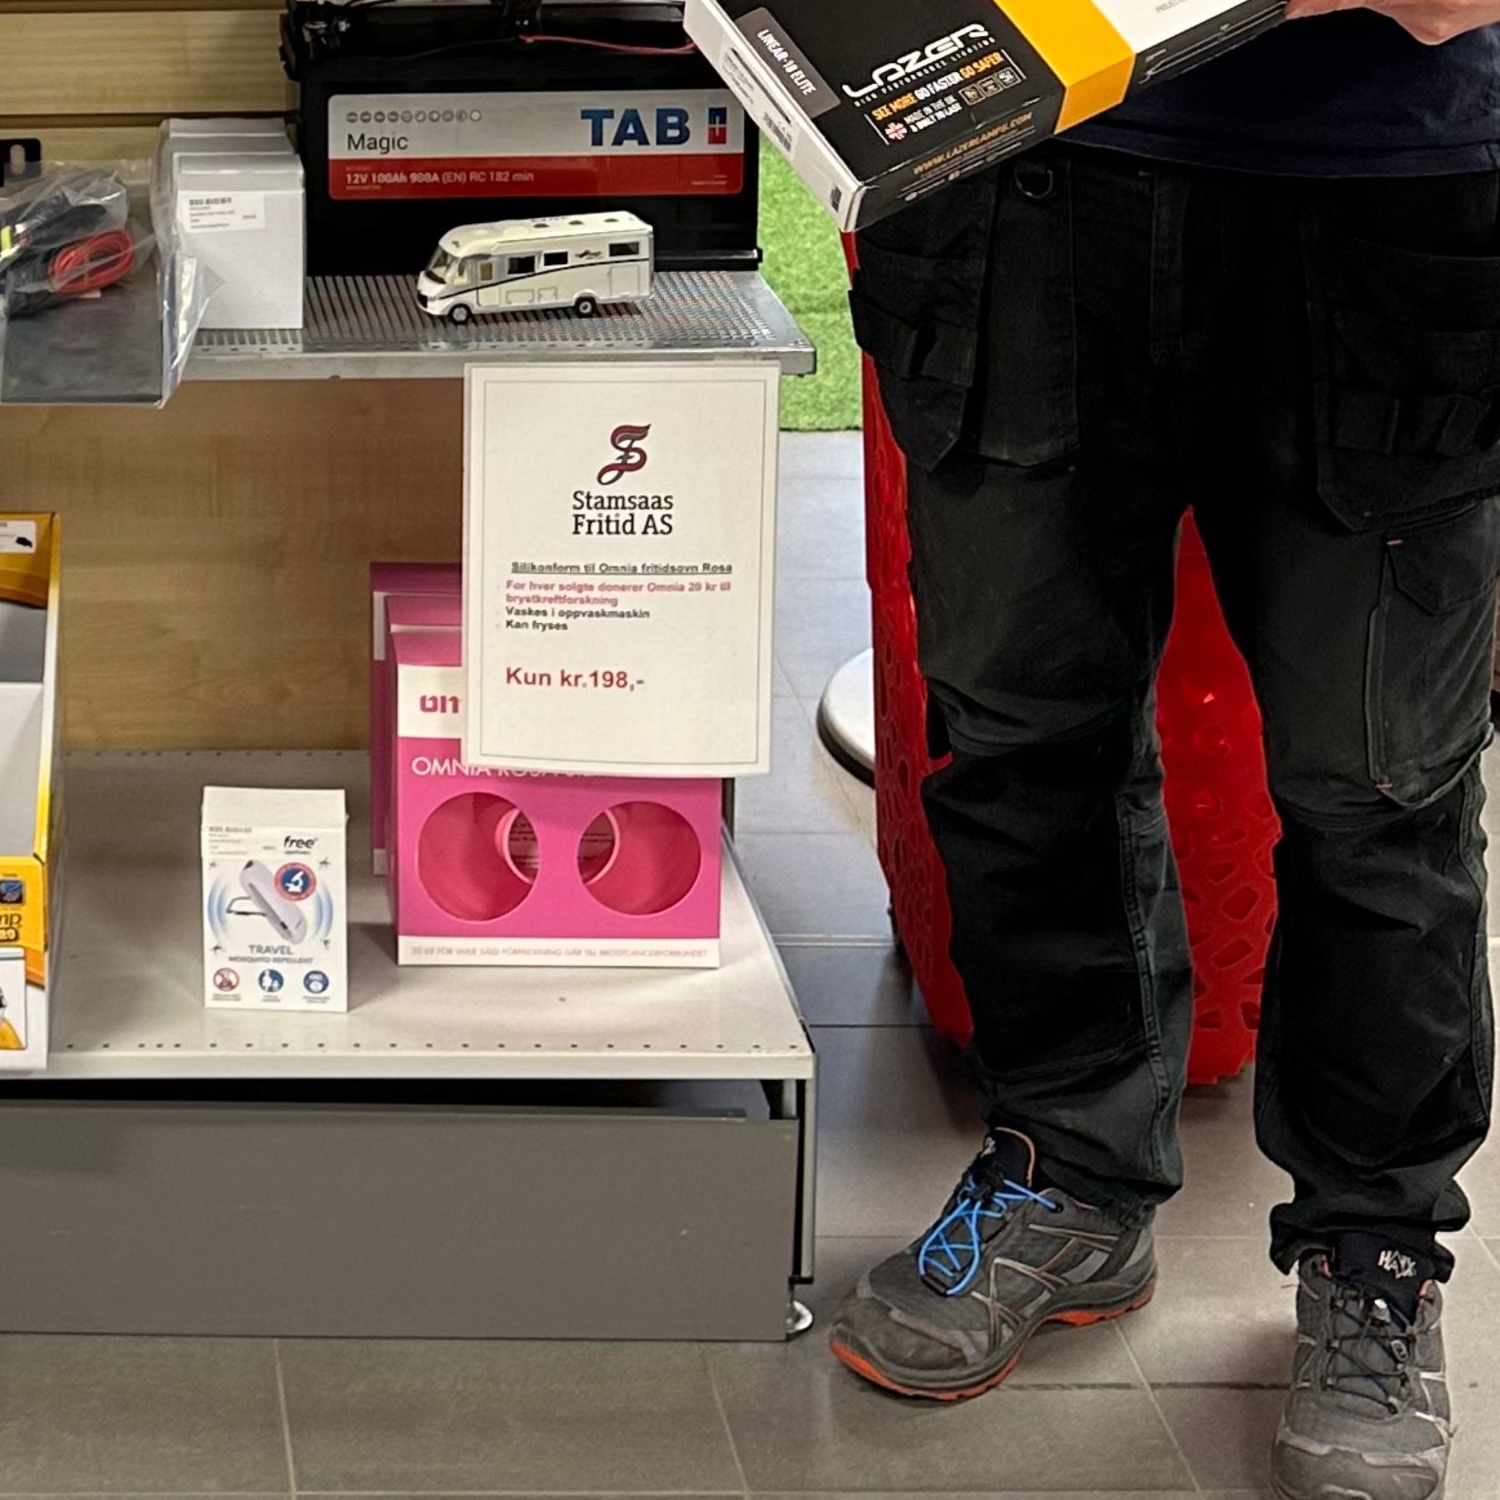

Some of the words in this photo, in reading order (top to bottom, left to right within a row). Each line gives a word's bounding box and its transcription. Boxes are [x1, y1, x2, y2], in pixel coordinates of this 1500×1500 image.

[842, 24, 988, 98] LAZER
[790, 64, 817, 96] ELITE
[871, 105, 893, 121] SEE
[914, 86, 931, 101] GO
[929, 72, 963, 95] FASTER
[959, 66, 976, 79] GO
[974, 52, 1004, 73] SAFER
[580, 108, 690, 146] TAB
[347, 133, 409, 155] Magic
[346, 173, 368, 184] 12V
[442, 170, 468, 185] (EN)
[469, 171, 486, 182] RC
[489, 170, 510, 182] 182
[512, 170, 534, 182] min
[572, 490, 674, 510] Stamsaas
[572, 513, 636, 536] Fritid
[641, 514, 674, 536] AS
[511, 562, 580, 574] Silikonform
[584, 562, 596, 574] til
[599, 563, 639, 574] Omnia
[641, 563, 699, 574] fritidsovn
[702, 564, 733, 574] Rosa
[506, 581, 525, 590] For
[529, 581, 555, 591] hver
[559, 581, 594, 594] solgte
[598, 582, 643, 592] donerer
[647, 582, 685, 592] Omnia
[705, 582, 717, 592] kr
[720, 582, 731, 592] til
[506, 607, 548, 617] Vaskes
[558, 609, 650, 620] oppvaskmaskin
[506, 620, 529, 630] Kan
[532, 621, 568, 632] fryses
[506, 667, 551, 687] Kun
[560, 669, 644, 691] kr.198,-
[283, 835, 315, 850] free
[248, 944, 294, 955] TRAVEL
[272, 956, 314, 964] REPELLENT
